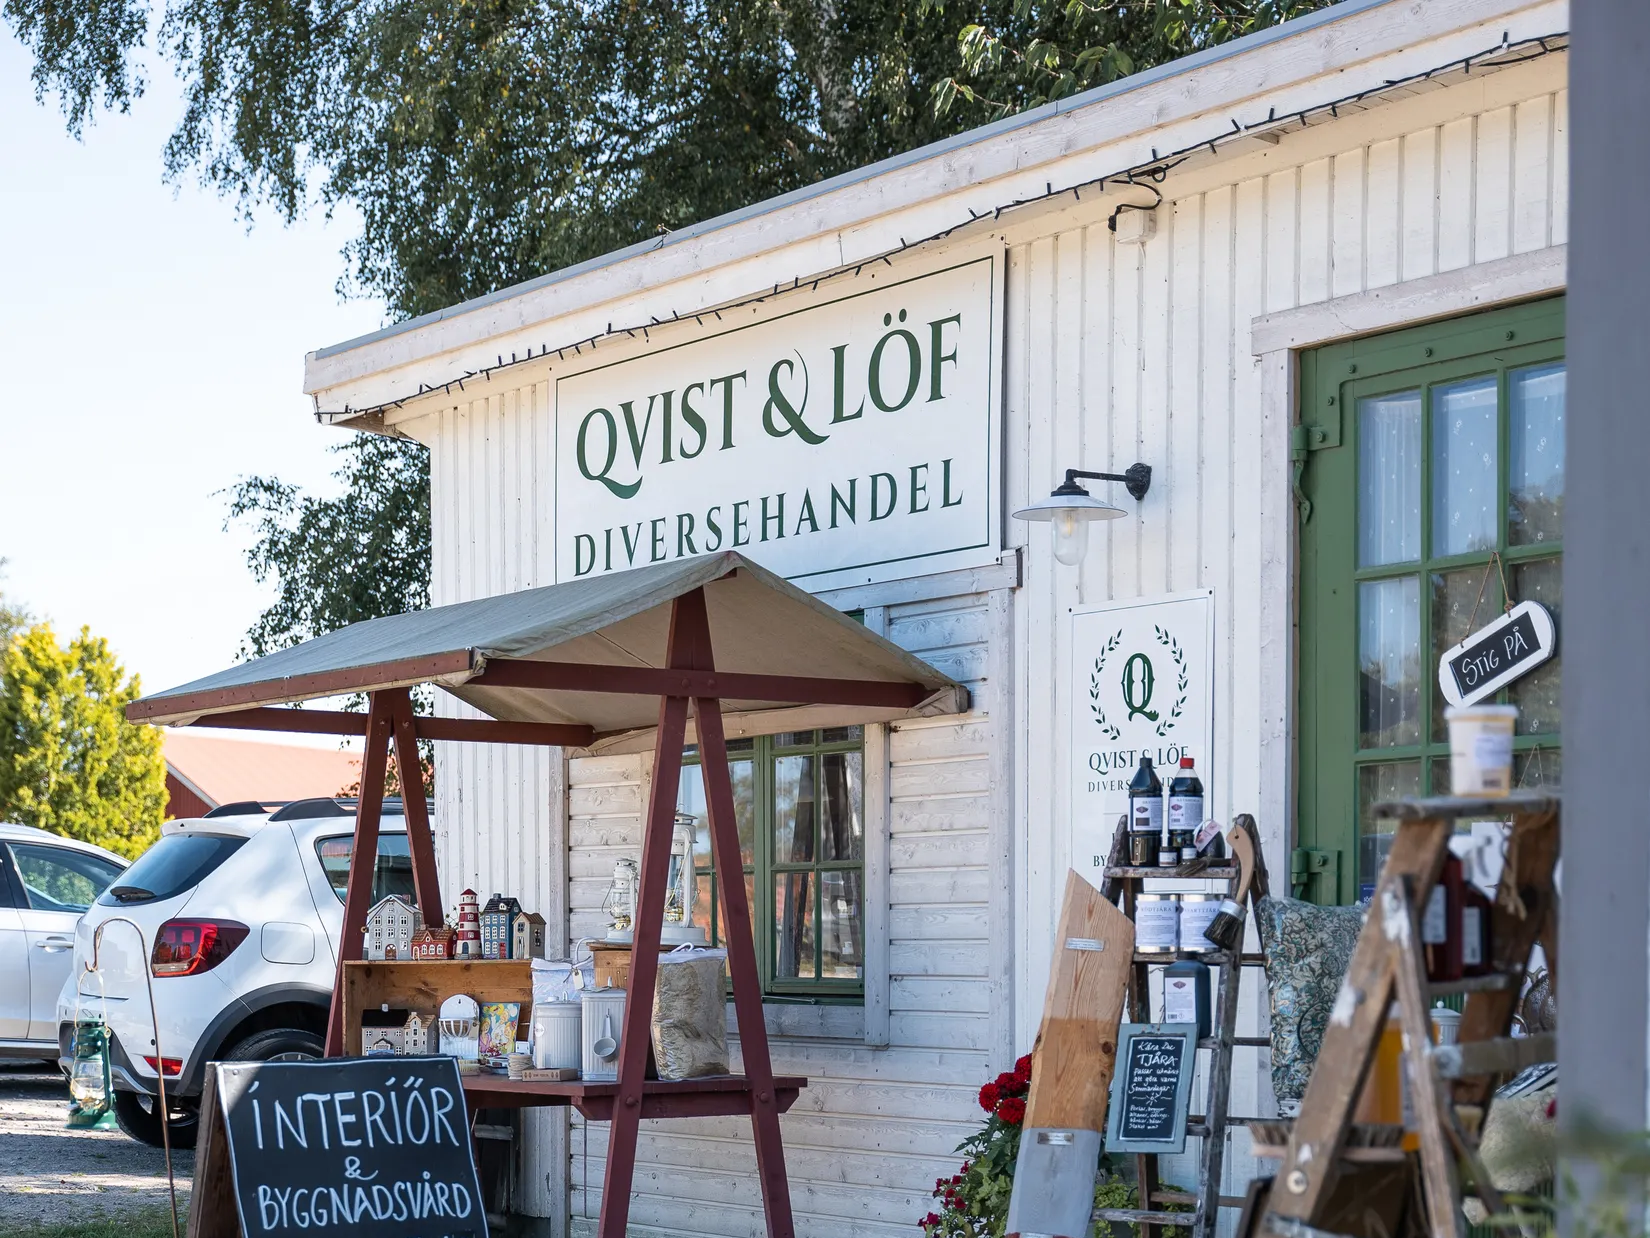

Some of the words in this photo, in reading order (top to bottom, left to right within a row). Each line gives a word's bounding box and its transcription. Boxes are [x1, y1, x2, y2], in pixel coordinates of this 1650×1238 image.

[576, 370, 747, 500] QVIST
[762, 348, 830, 445] &
[830, 308, 962, 425] LÖF
[574, 458, 963, 577] DIVERSEHANDEL
[1462, 649, 1499, 686] STIG
[1503, 626, 1528, 660] PÅ
[1121, 652, 1159, 722] Q
[1089, 750, 1137, 776] QVIST
[1158, 743, 1188, 766] LÖF
[1136, 1051, 1178, 1067] TJÄRA
[343, 1155, 379, 1181] &
[258, 1171, 473, 1231] BYGGNADSVÅRD
